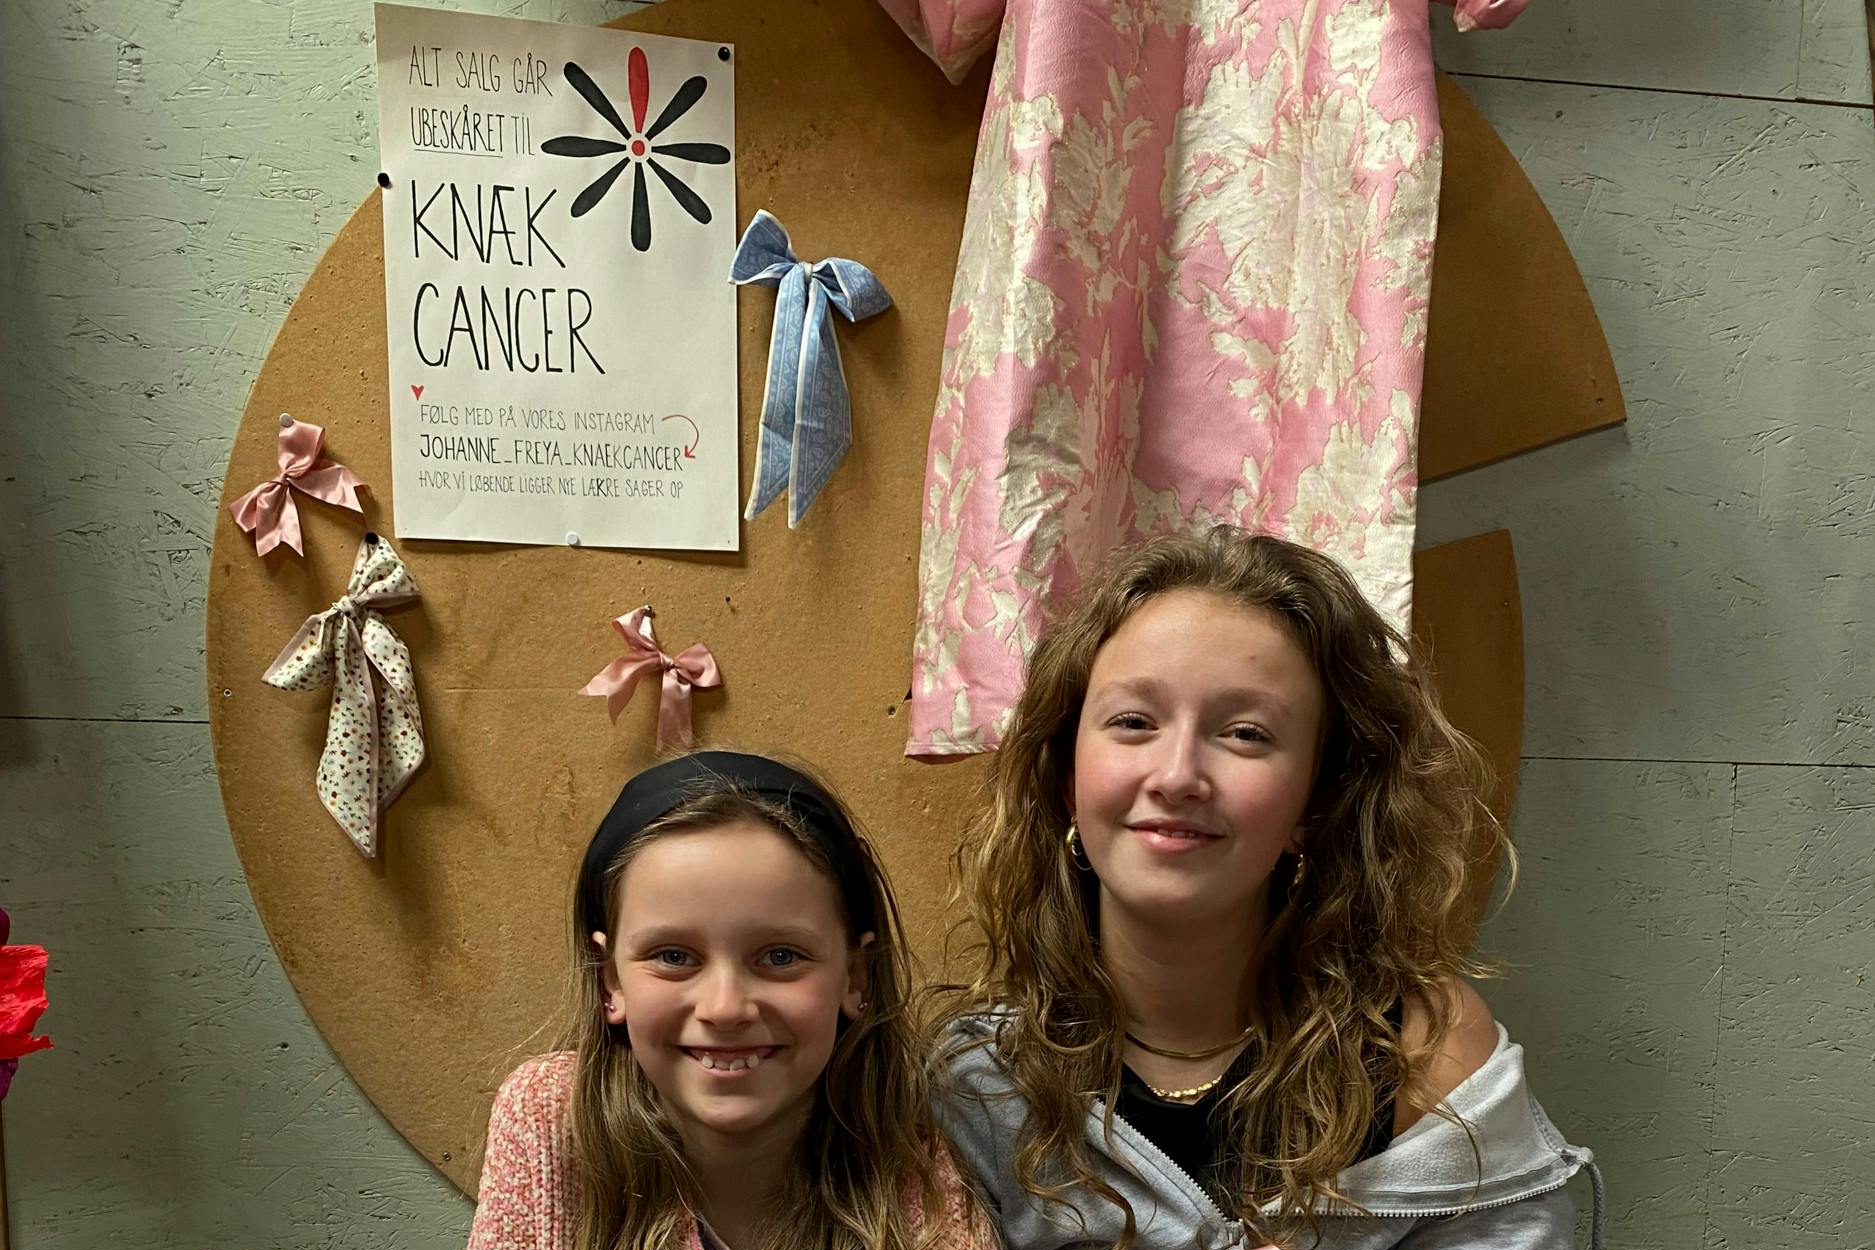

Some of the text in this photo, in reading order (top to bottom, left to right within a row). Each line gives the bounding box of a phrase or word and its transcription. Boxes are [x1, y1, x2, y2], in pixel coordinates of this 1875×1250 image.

[409, 45, 553, 96] ALT SALG GÅR
[410, 104, 505, 153] UBESKÅRET
[411, 179, 566, 268] KNÆK
[413, 282, 606, 375] CANCER
[420, 403, 656, 436] FØLG MED PÅ VORES INSTAGRAM
[418, 470, 451, 490] HVOR
[469, 473, 516, 494] LØBENDE
[558, 476, 578, 497] NYE
[582, 478, 621, 498] LÆKRE
[625, 479, 665, 498] SAGER
[670, 480, 685, 499] OP
